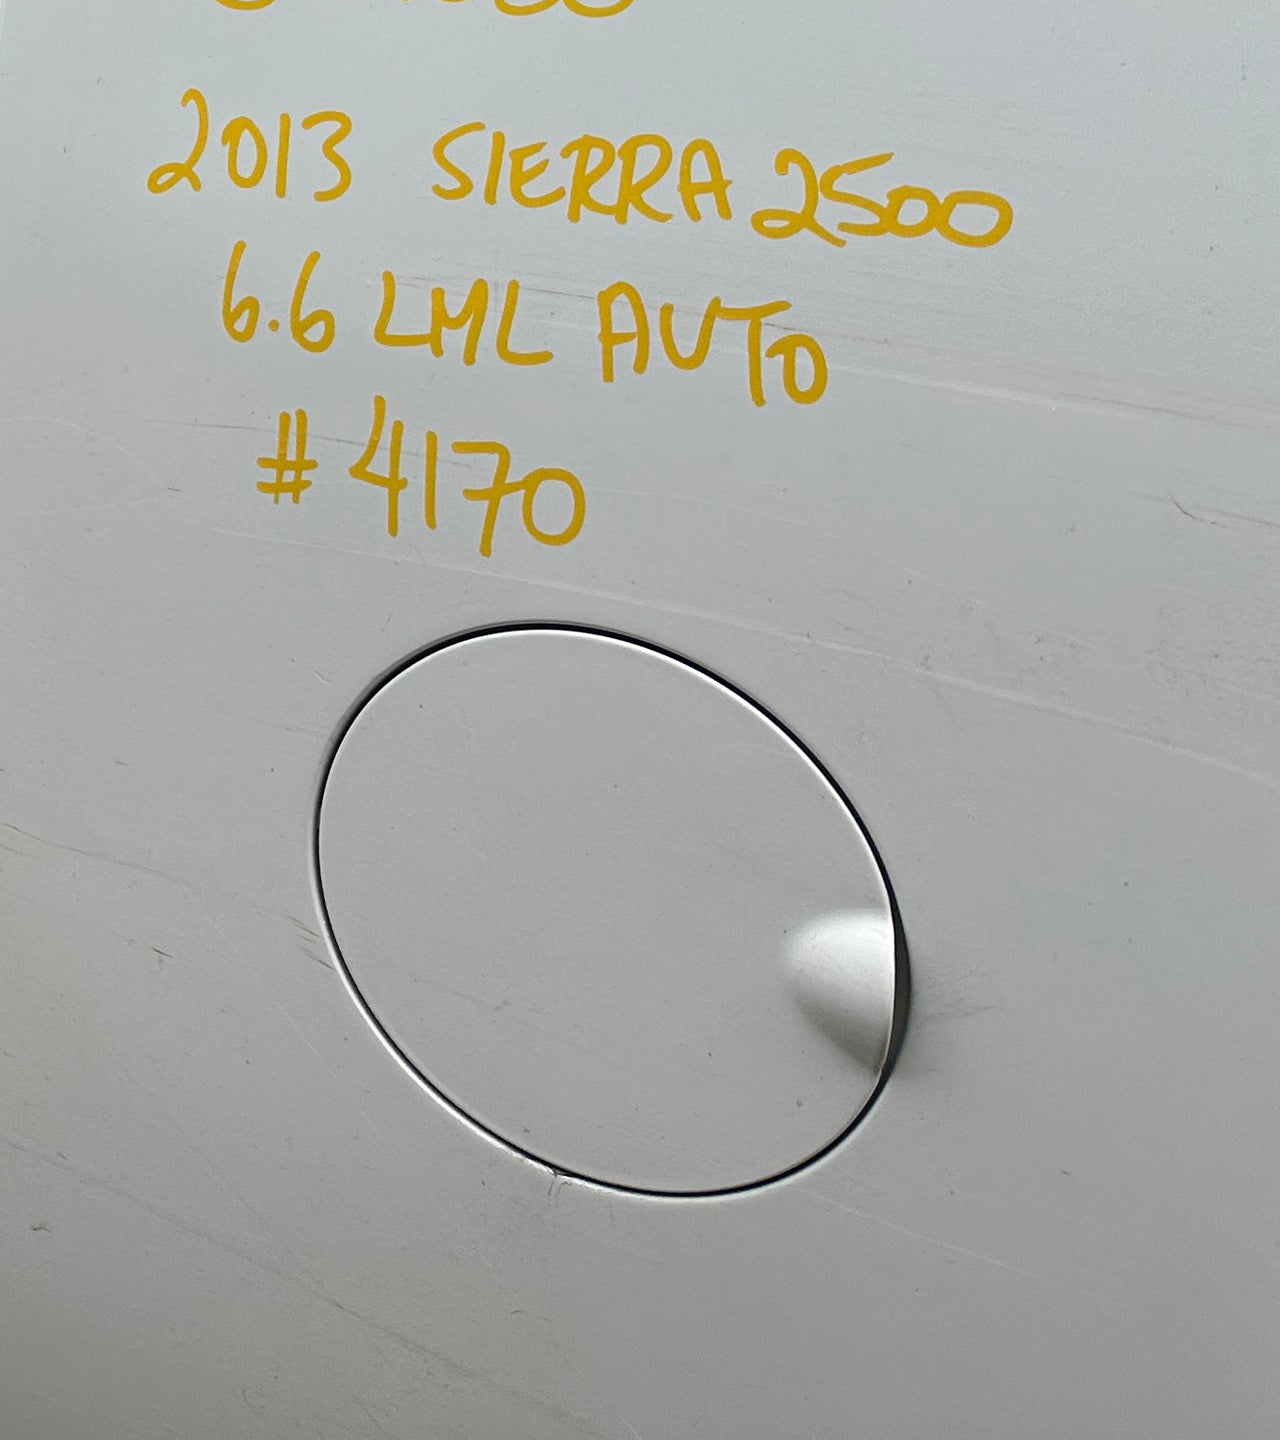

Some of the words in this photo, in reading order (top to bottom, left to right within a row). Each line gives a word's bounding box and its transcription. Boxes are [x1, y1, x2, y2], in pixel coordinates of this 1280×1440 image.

[147, 89, 353, 202] 2013
[431, 122, 732, 225] SIERRA
[751, 148, 1014, 248] 2500
[222, 241, 336, 353] 6.6
[373, 271, 554, 365] LML
[596, 281, 829, 407] AUTO
